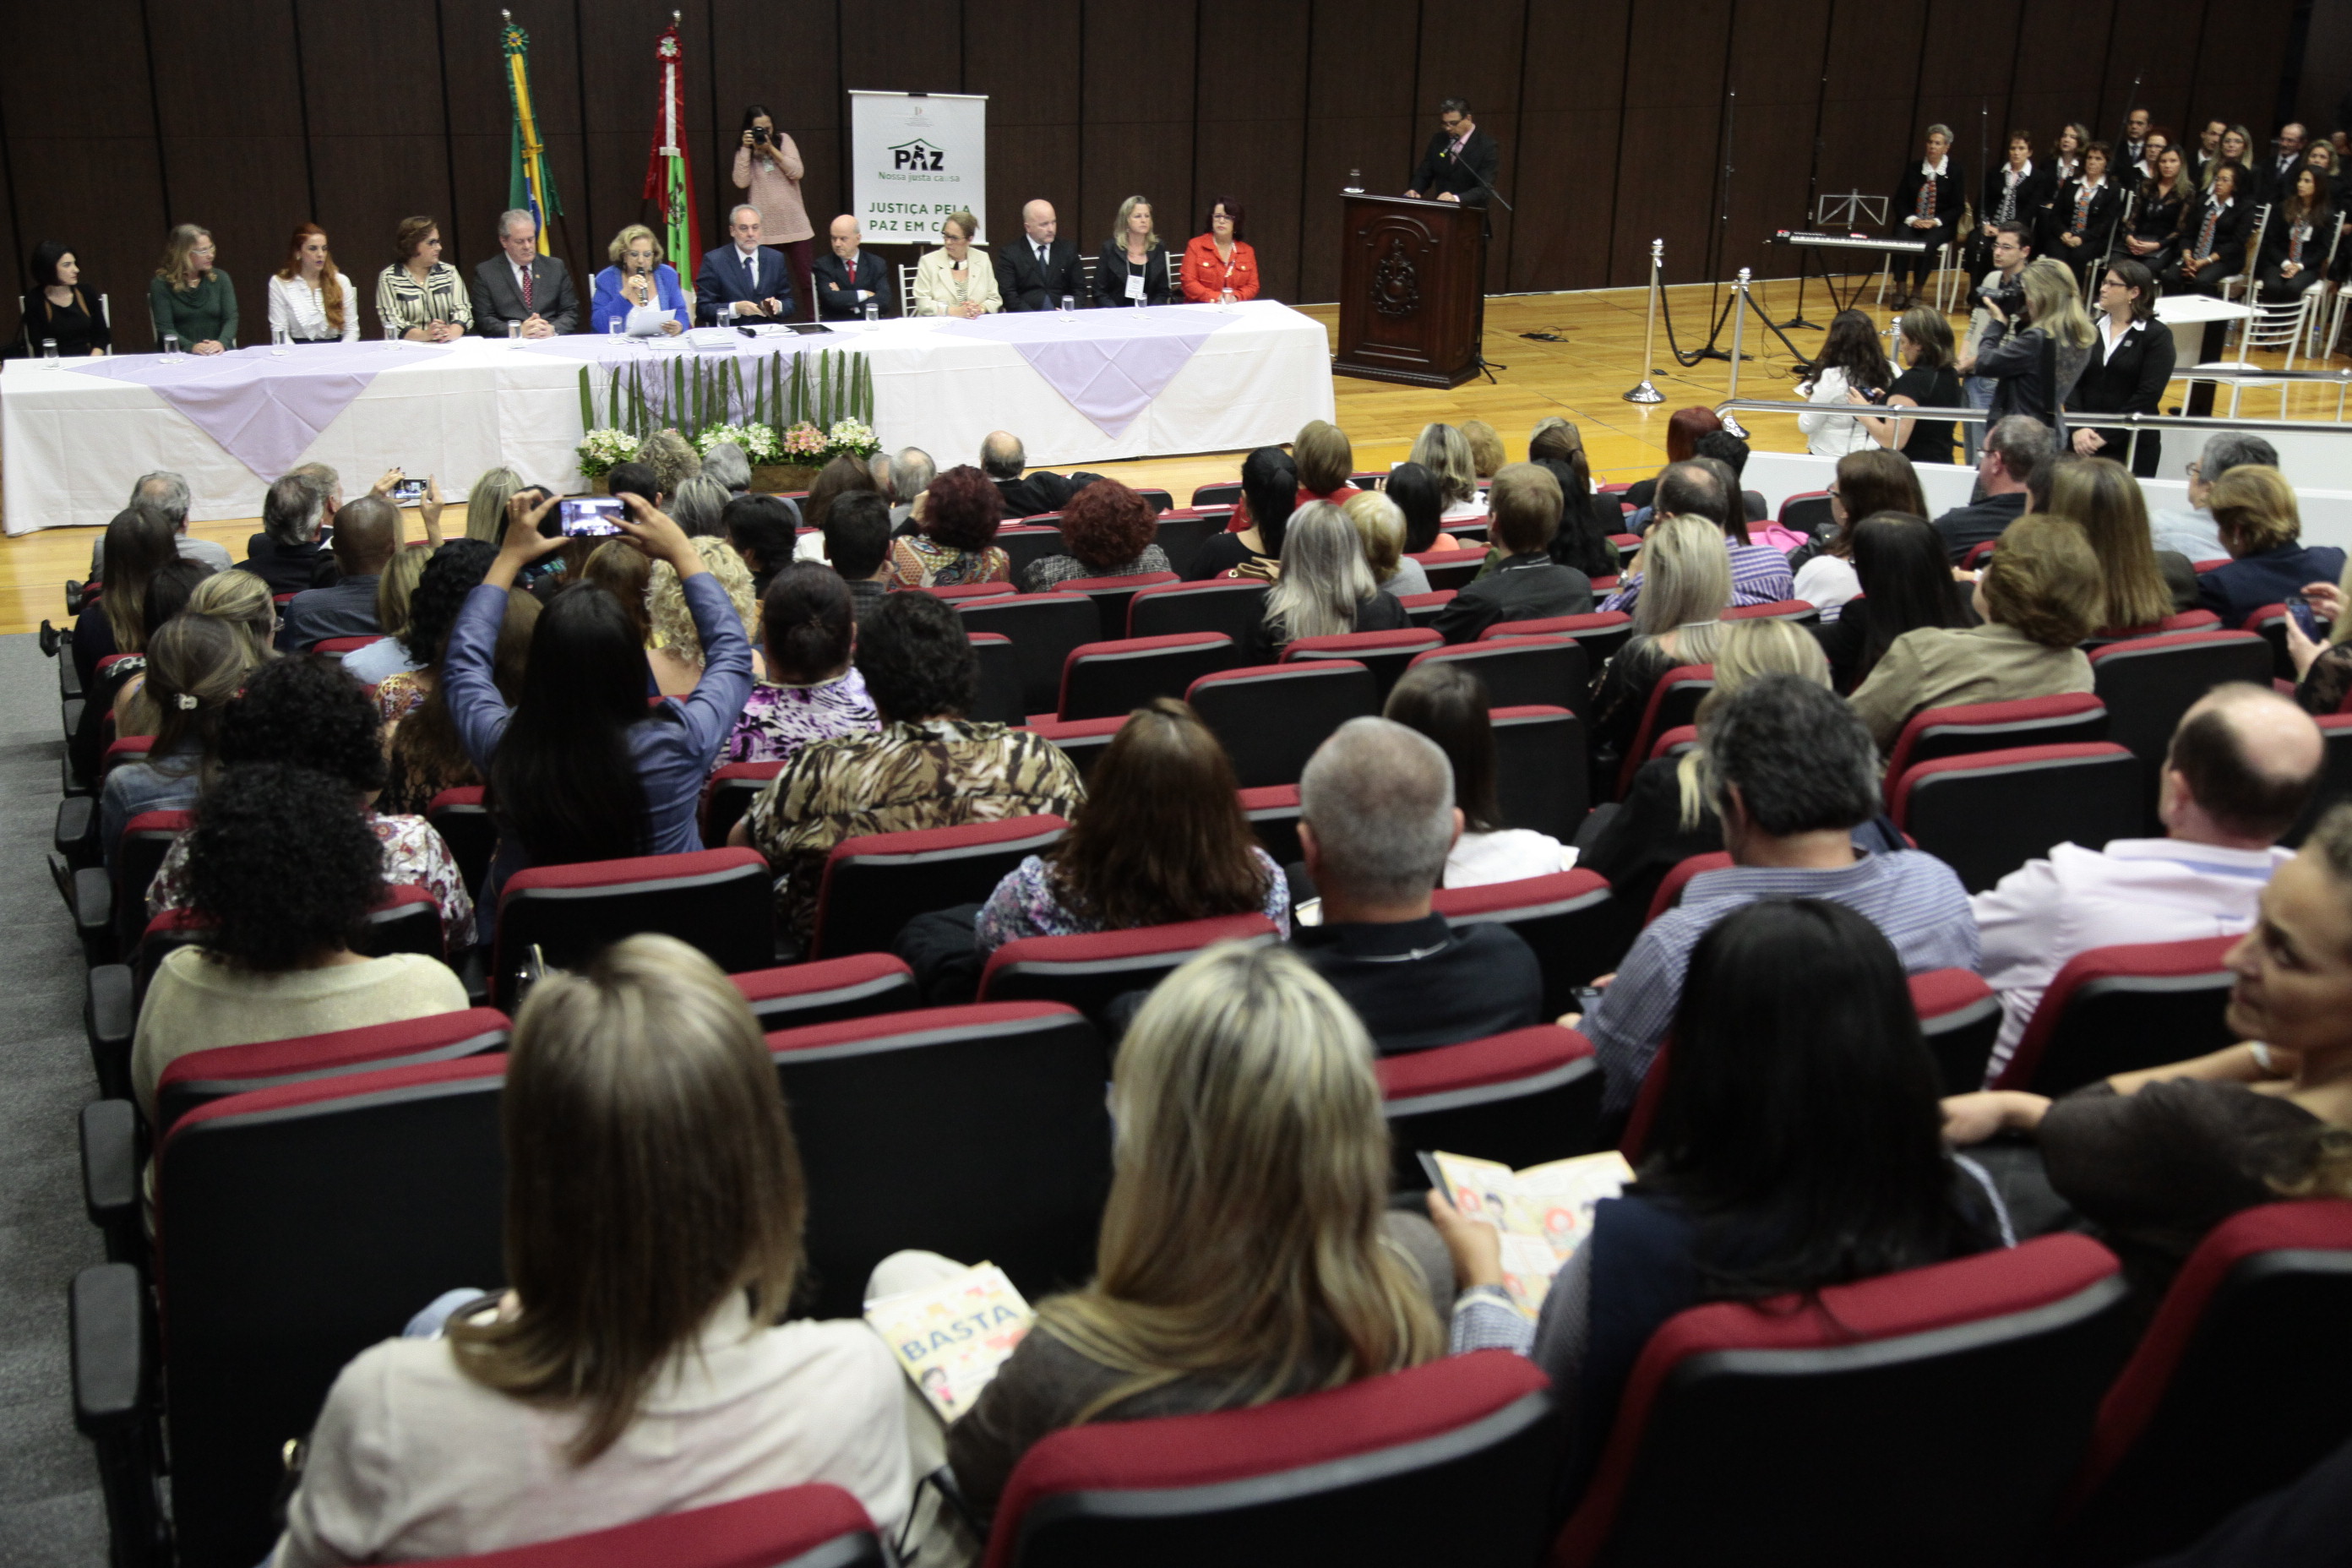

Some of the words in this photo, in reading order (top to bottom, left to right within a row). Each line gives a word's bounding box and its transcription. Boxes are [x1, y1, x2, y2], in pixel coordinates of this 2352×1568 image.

[895, 149, 944, 171] PAZ
[878, 172, 906, 180] Nossa
[907, 172, 931, 182] justa
[869, 202, 928, 215] JUSTIÇA
[869, 220, 898, 231] PAZ
[905, 221, 924, 231] EM
[901, 1304, 1018, 1362] BASTA
